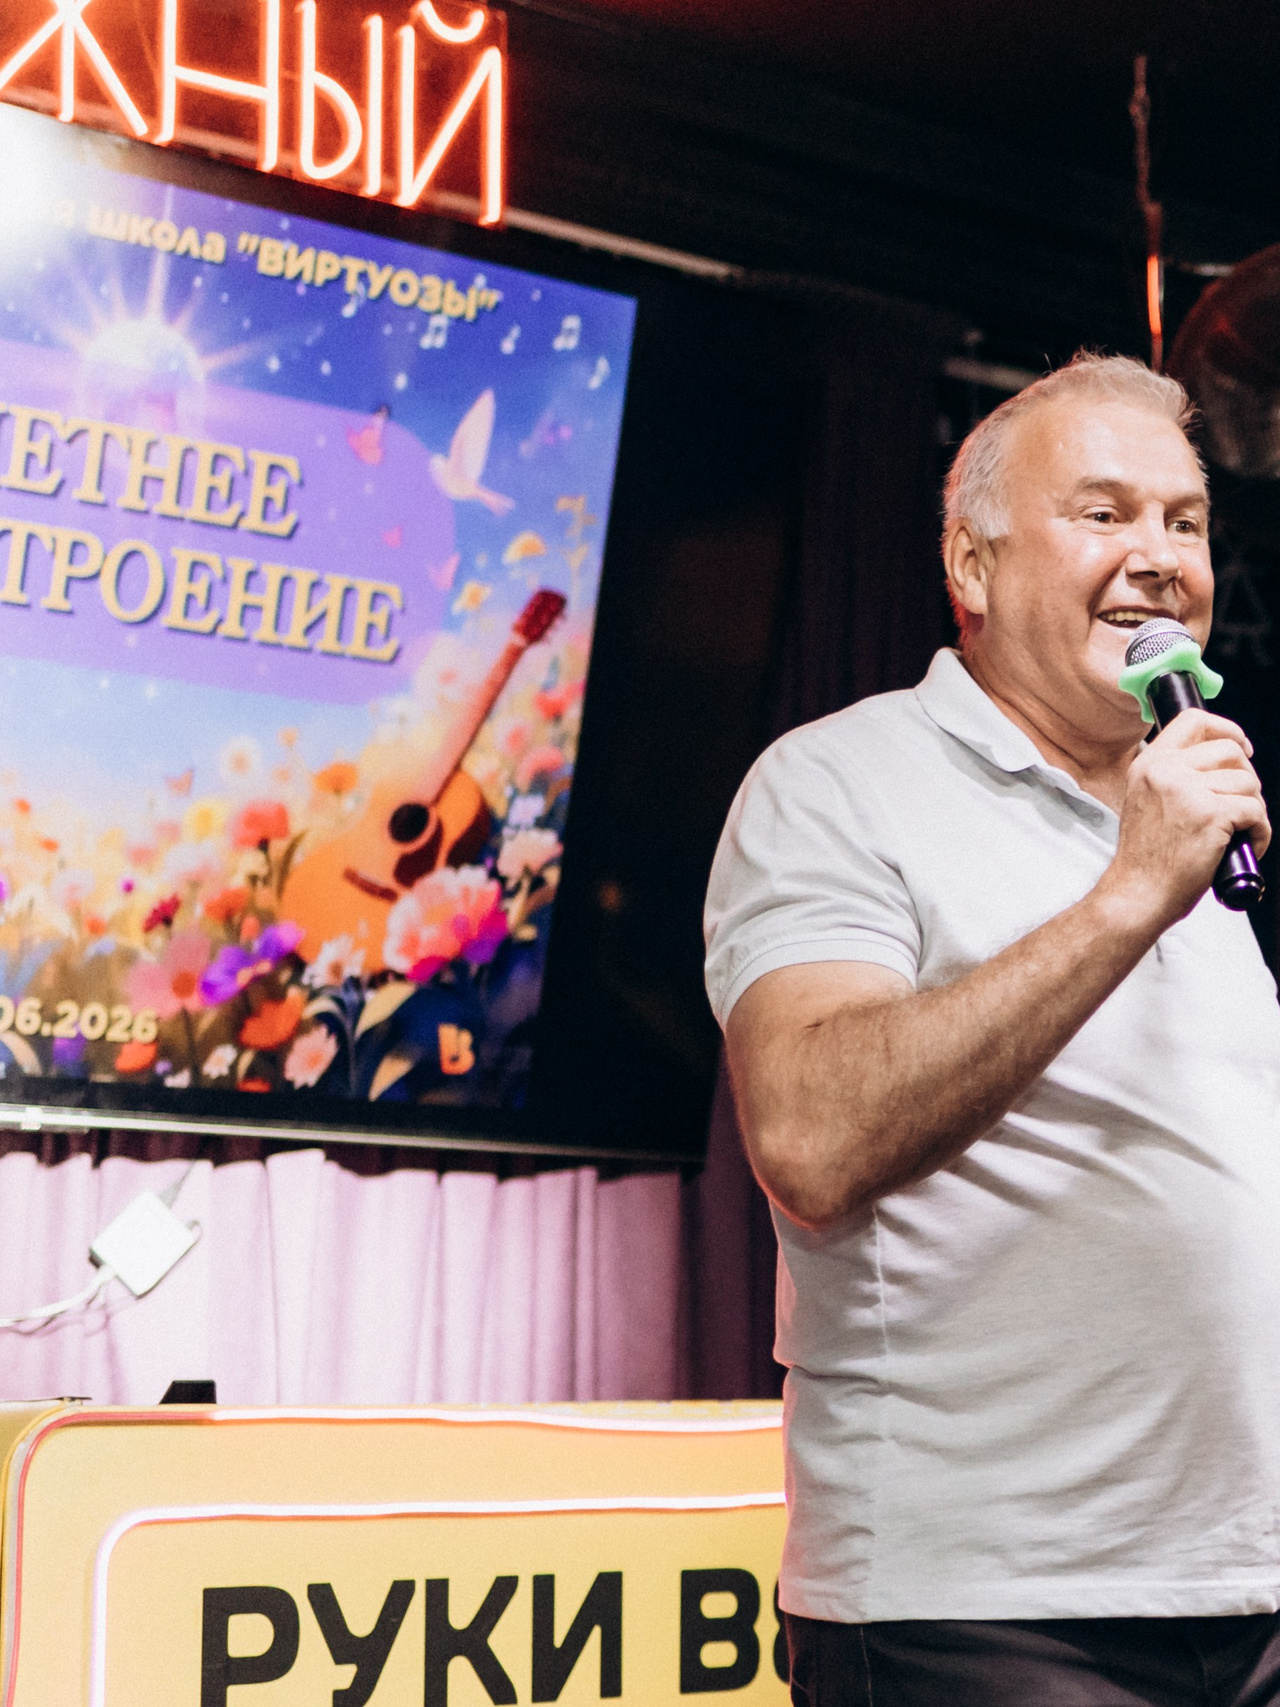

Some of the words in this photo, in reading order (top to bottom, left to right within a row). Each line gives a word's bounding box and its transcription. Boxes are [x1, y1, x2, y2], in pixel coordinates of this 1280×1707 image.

[0, 0, 503, 225] ЖНЫЙ
[88, 205, 227, 264] школа
[0, 402, 302, 538] ЕТНЕЕ
[0, 518, 404, 663] ТРОЕНИЕ
[200, 1570, 623, 1707] РУКИ
[679, 1567, 793, 1695] В
